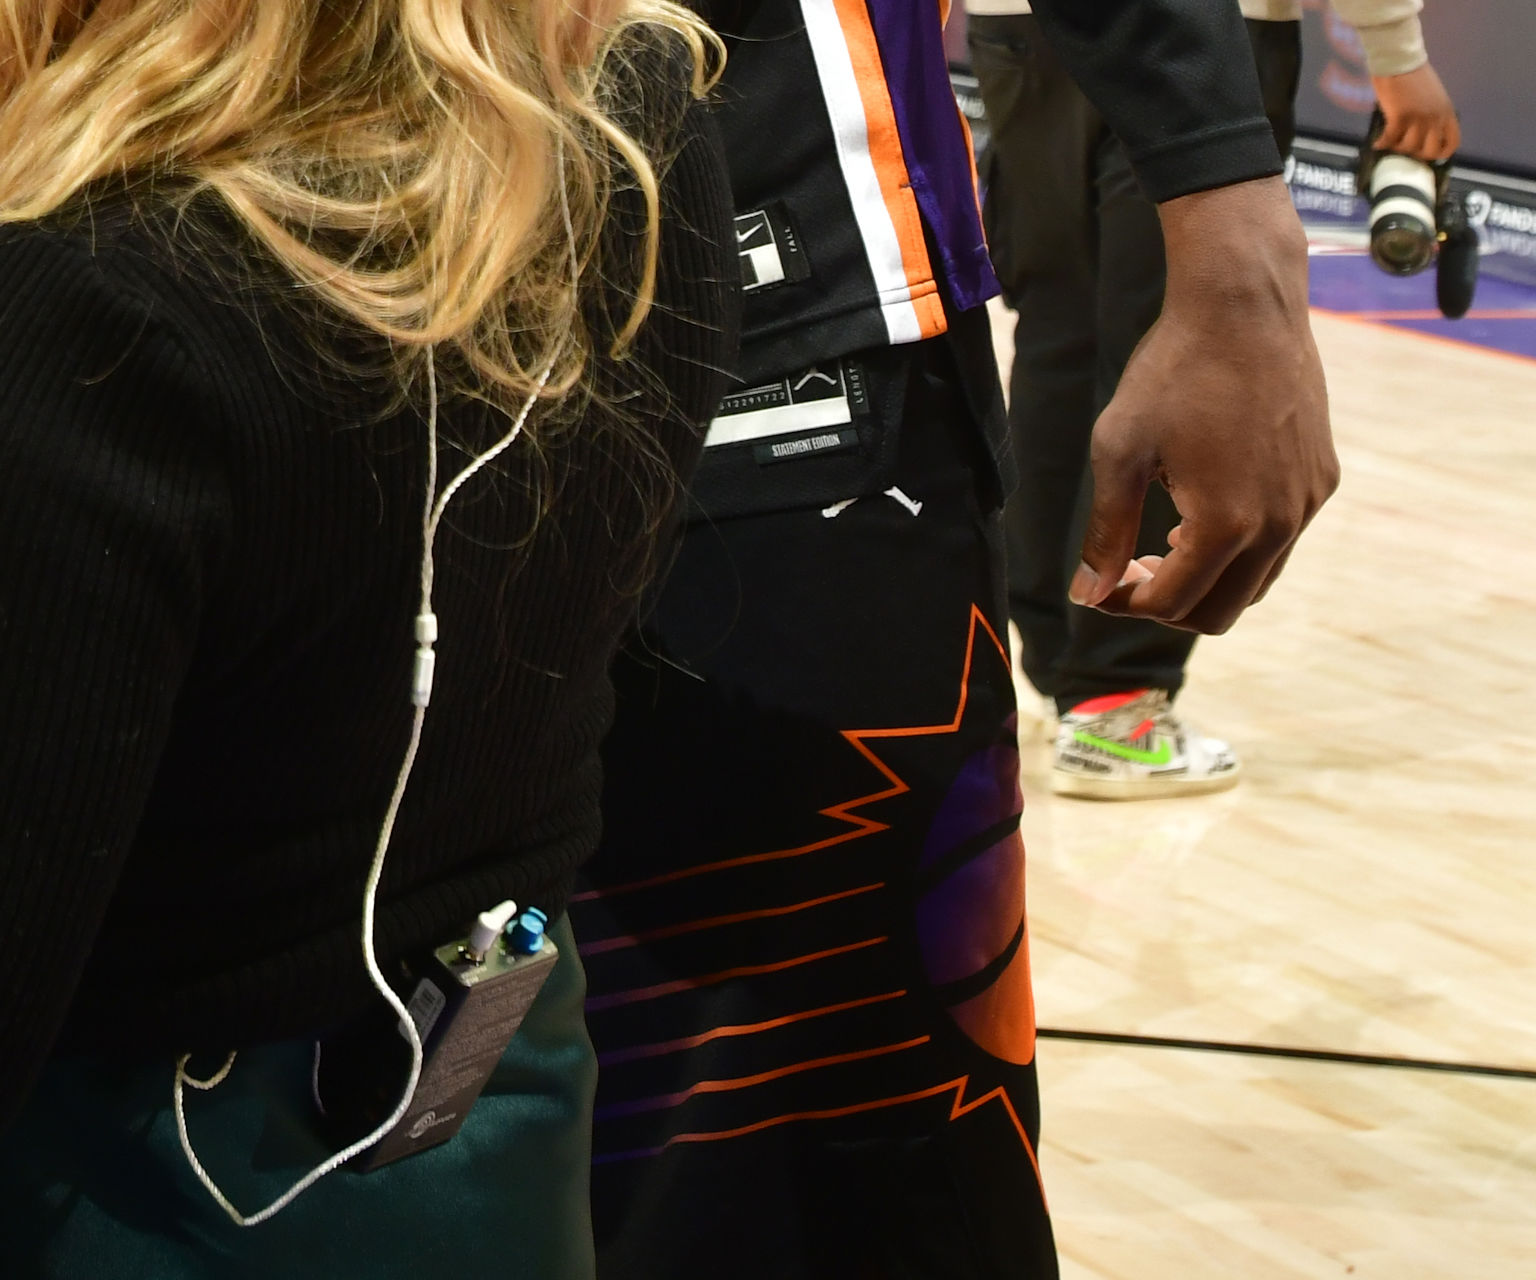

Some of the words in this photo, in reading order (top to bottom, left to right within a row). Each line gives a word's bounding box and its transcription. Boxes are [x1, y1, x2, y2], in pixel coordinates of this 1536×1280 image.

[1292, 161, 1357, 197] FANDUE
[771, 437, 813, 458] STATEMENT
[811, 432, 841, 450] EDITION
